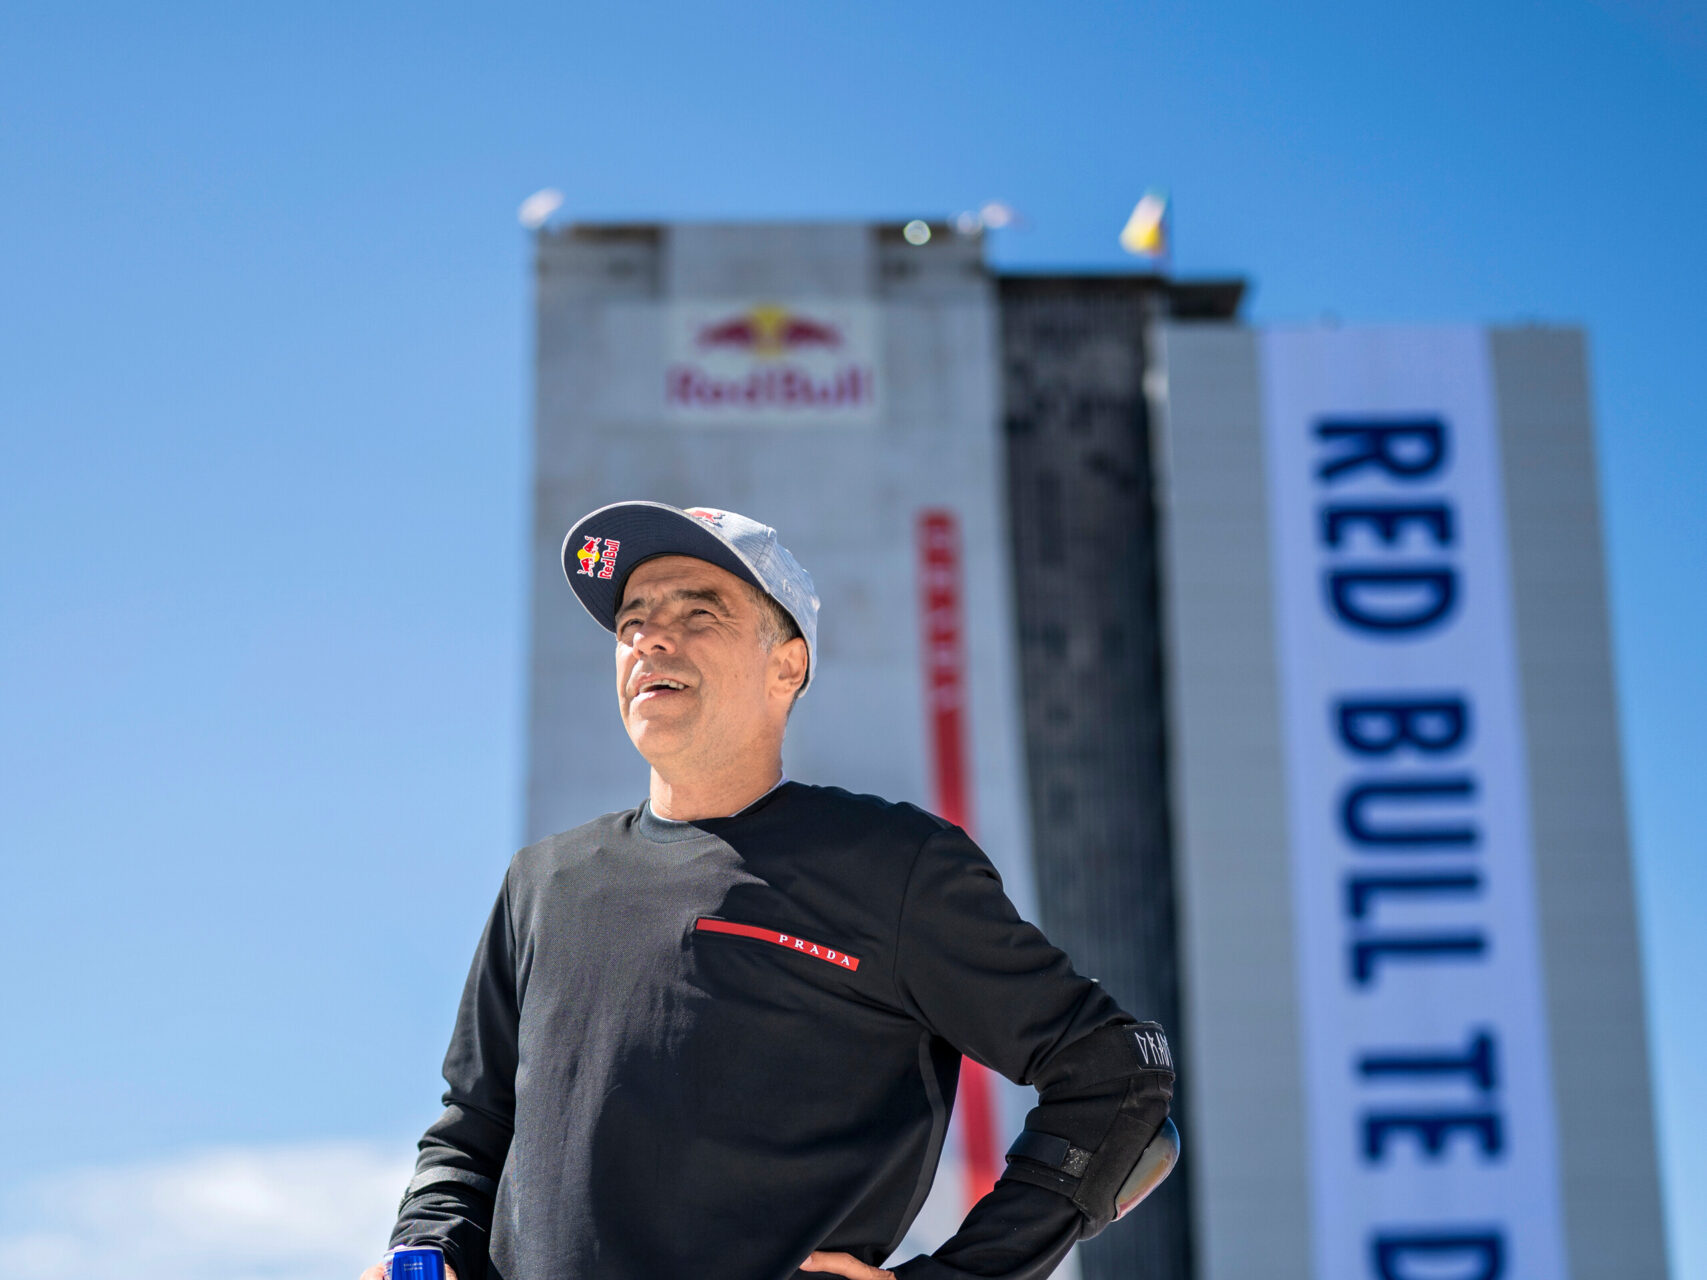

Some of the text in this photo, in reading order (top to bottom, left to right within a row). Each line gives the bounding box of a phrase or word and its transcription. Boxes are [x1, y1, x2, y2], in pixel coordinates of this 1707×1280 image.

[665, 364, 874, 407] Red Bull
[598, 539, 620, 579] Red Bull
[1312, 416, 1461, 641] RED
[1333, 696, 1487, 988] BULL
[778, 934, 851, 966] PRADA
[1356, 1029, 1507, 1165] TE
